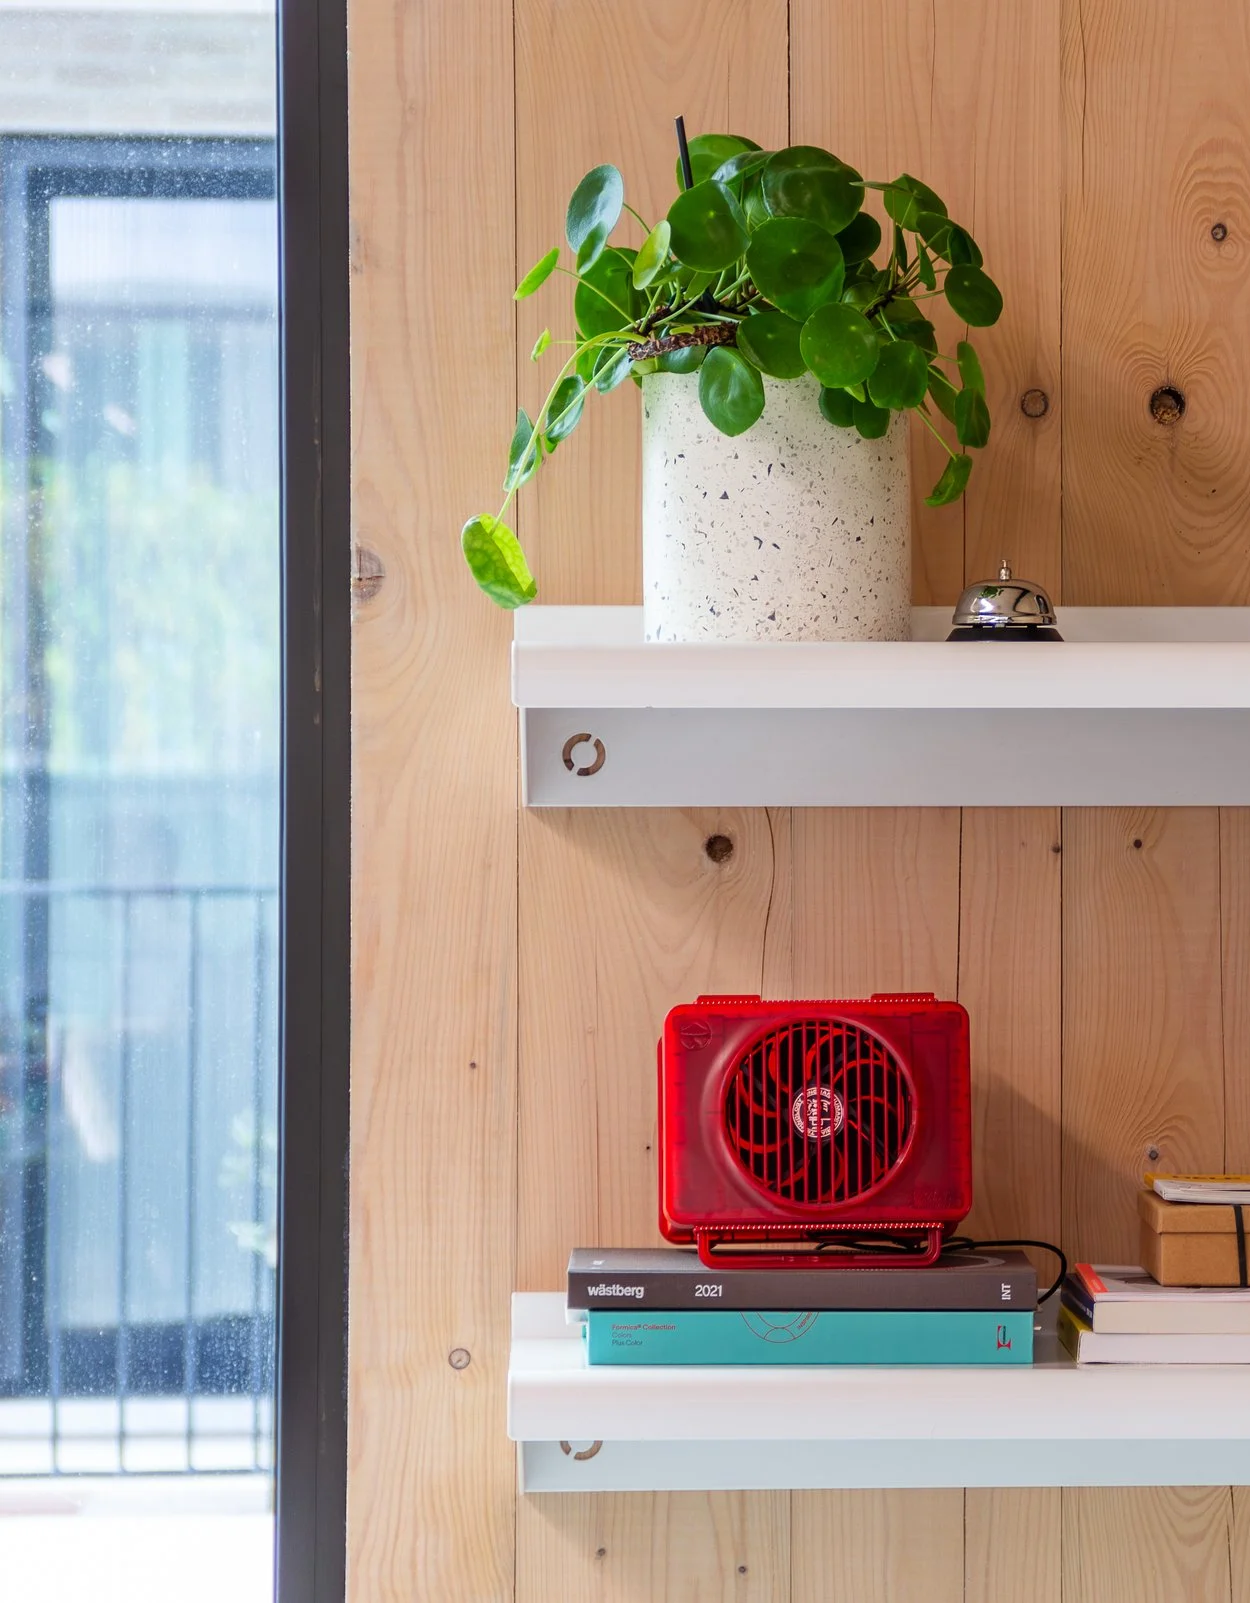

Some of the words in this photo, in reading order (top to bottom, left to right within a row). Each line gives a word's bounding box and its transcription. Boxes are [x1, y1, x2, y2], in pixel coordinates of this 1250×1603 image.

[587, 1284, 645, 1300] wästberg
[694, 1284, 723, 1298] 2021
[1001, 1283, 1011, 1301] INT
[611, 1331, 632, 1339] Colors
